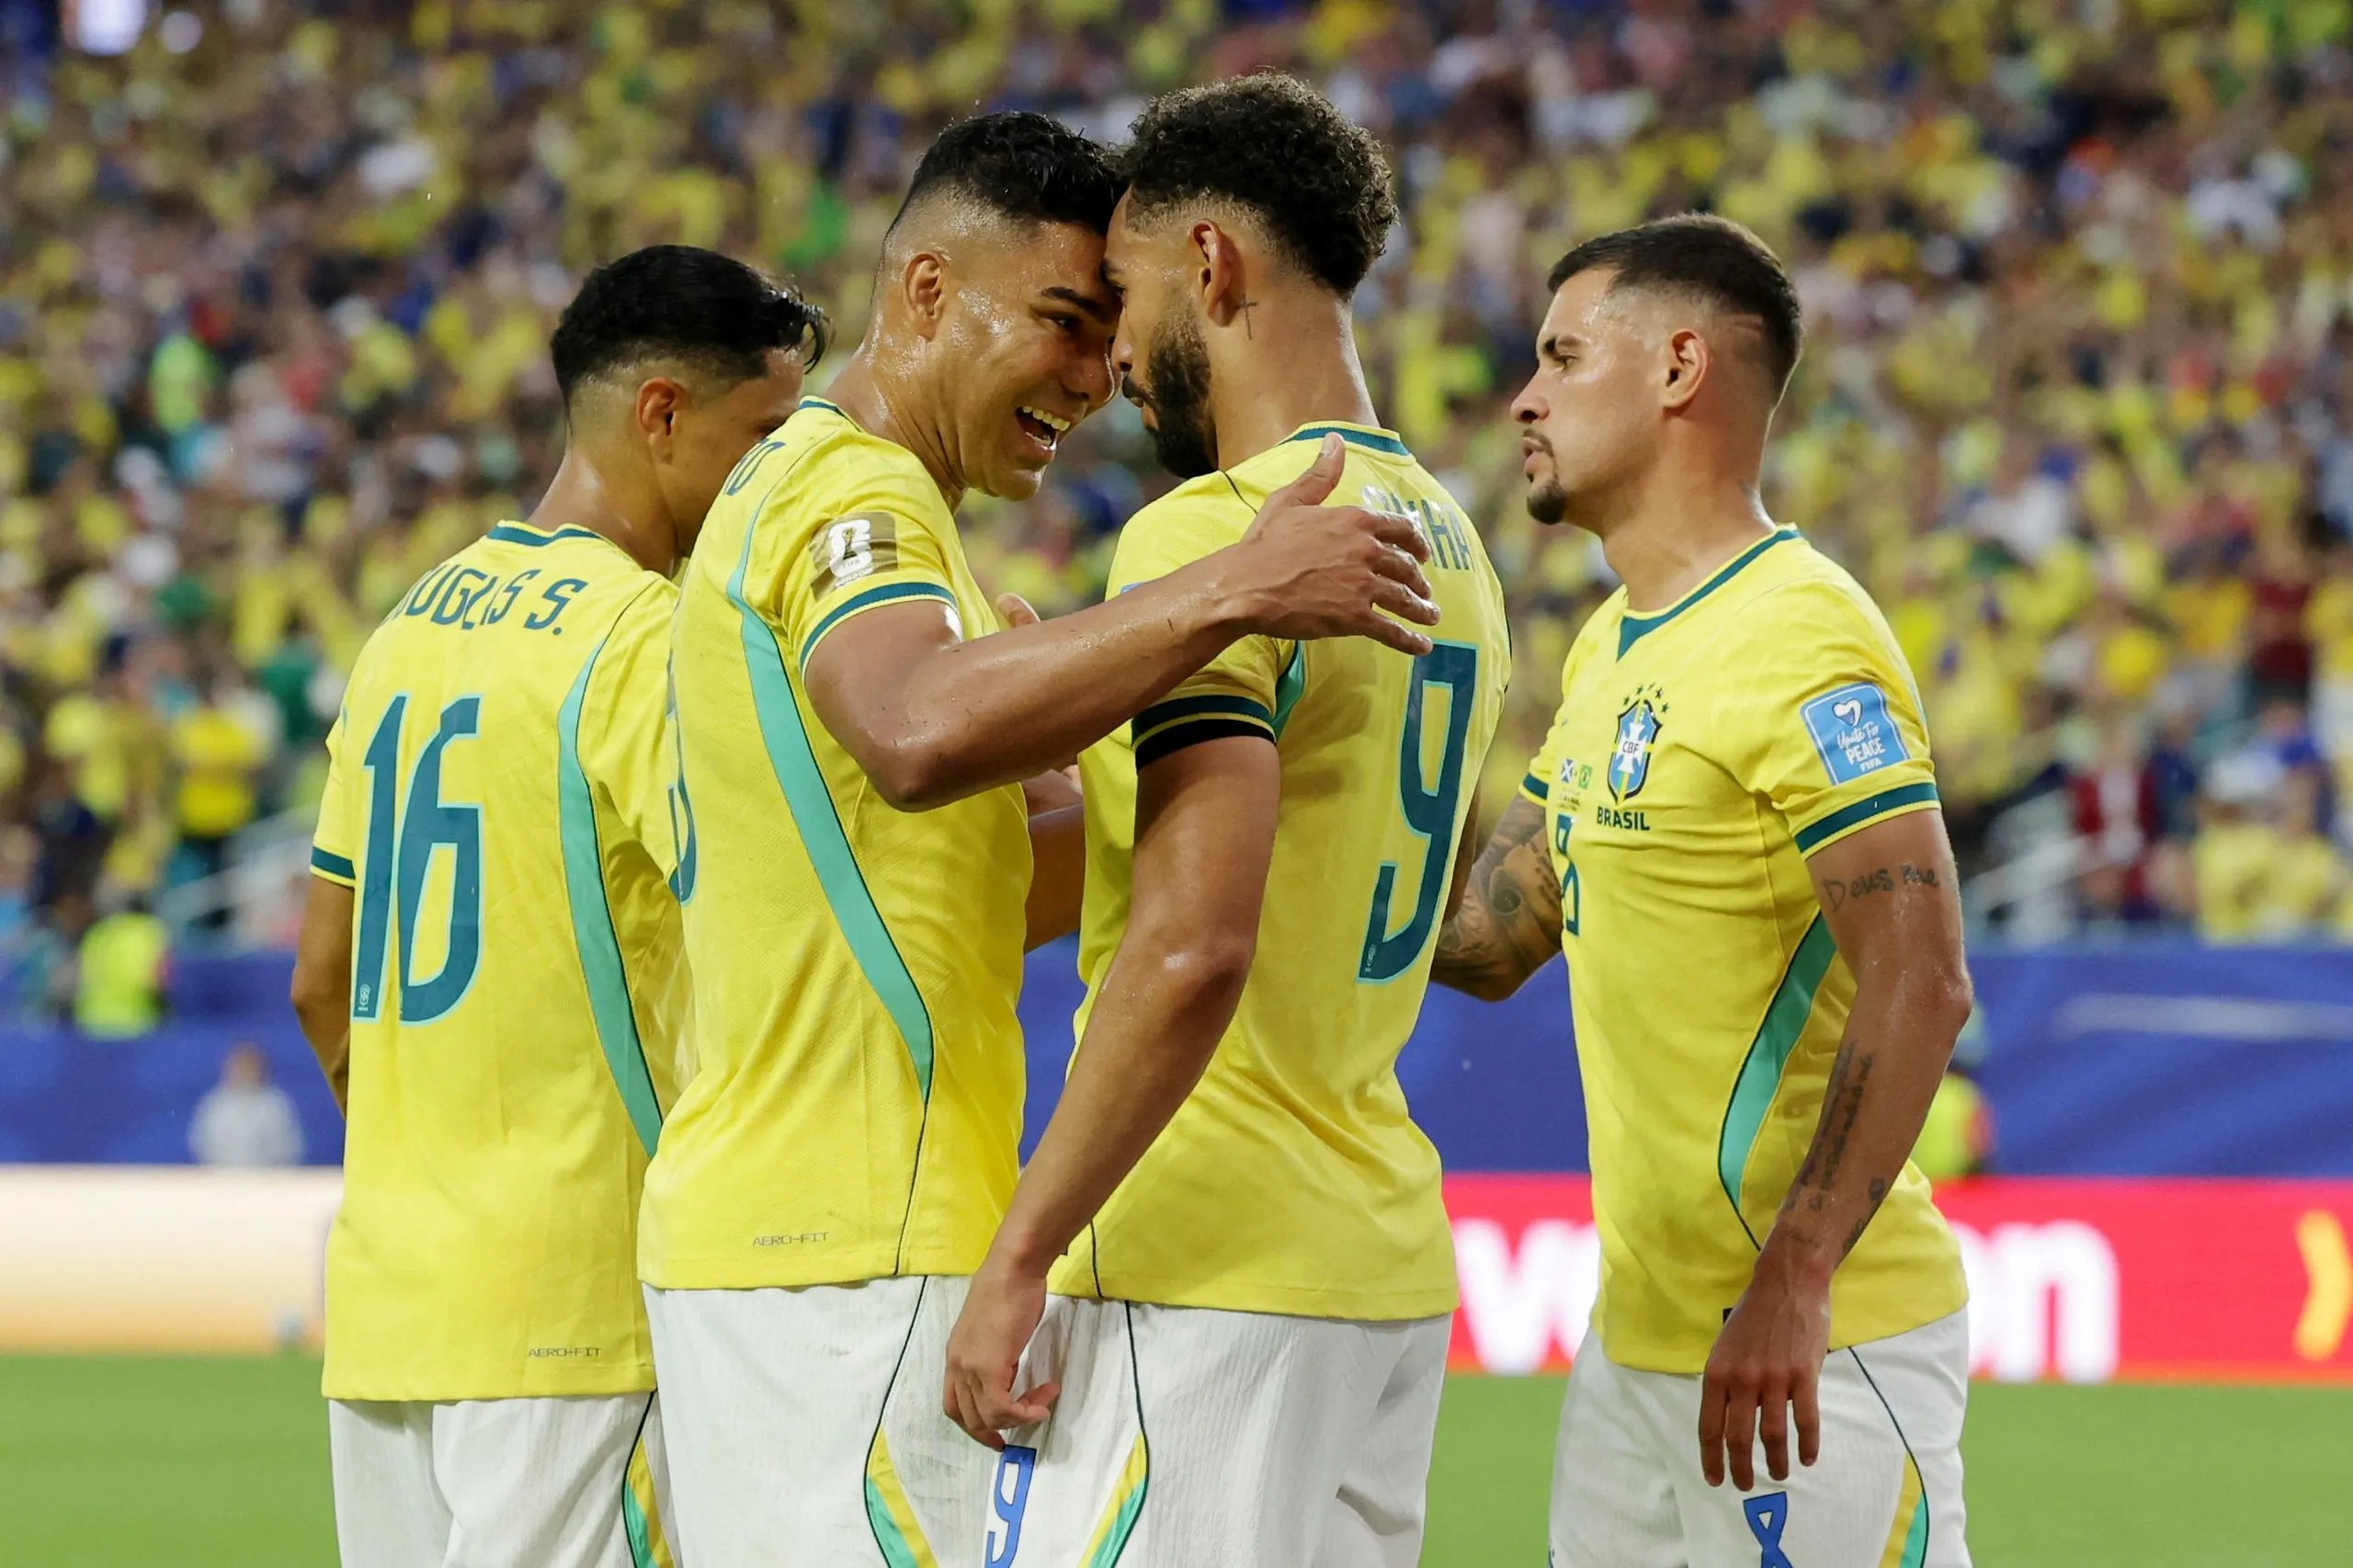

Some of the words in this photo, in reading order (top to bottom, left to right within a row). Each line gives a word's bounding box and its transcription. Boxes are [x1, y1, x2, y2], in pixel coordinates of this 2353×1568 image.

[523, 578, 589, 636] S.
[1621, 740, 1640, 755] CBF
[1845, 737, 1886, 766] PEACE
[1355, 639, 1478, 984] 9
[1597, 806, 1651, 831] BRASIL
[351, 691, 484, 1026] 16
[752, 1231, 830, 1247] AERO-FIT
[529, 1346, 602, 1358] AERO-FIT
[984, 1444, 1038, 1568] 9
